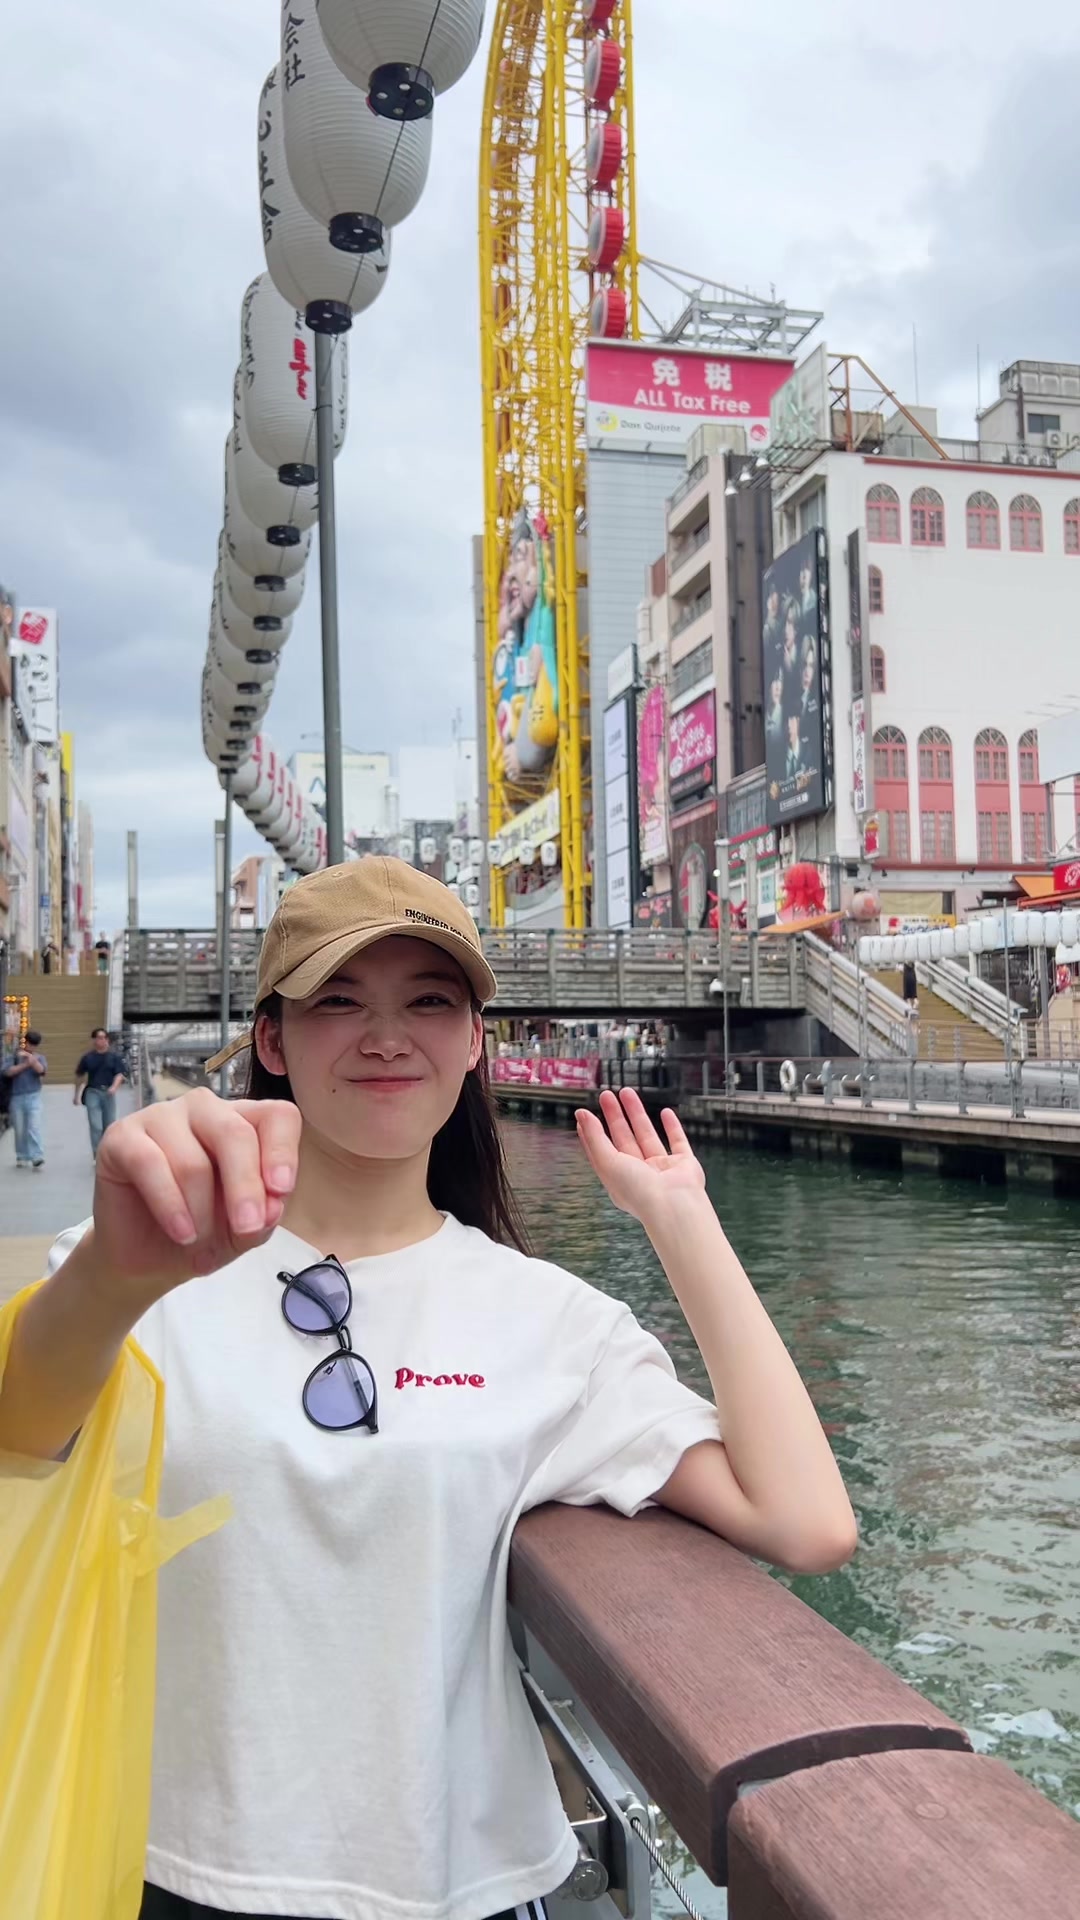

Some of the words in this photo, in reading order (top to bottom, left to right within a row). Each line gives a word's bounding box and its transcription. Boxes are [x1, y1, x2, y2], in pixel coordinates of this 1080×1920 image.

[283, 0, 306, 94] 会社
[652, 357, 732, 391] 免税
[634, 388, 667, 407] ALL
[672, 391, 705, 411] Tax
[711, 394, 751, 414] Free
[620, 419, 641, 429] Don
[394, 1367, 486, 1390] Prove
